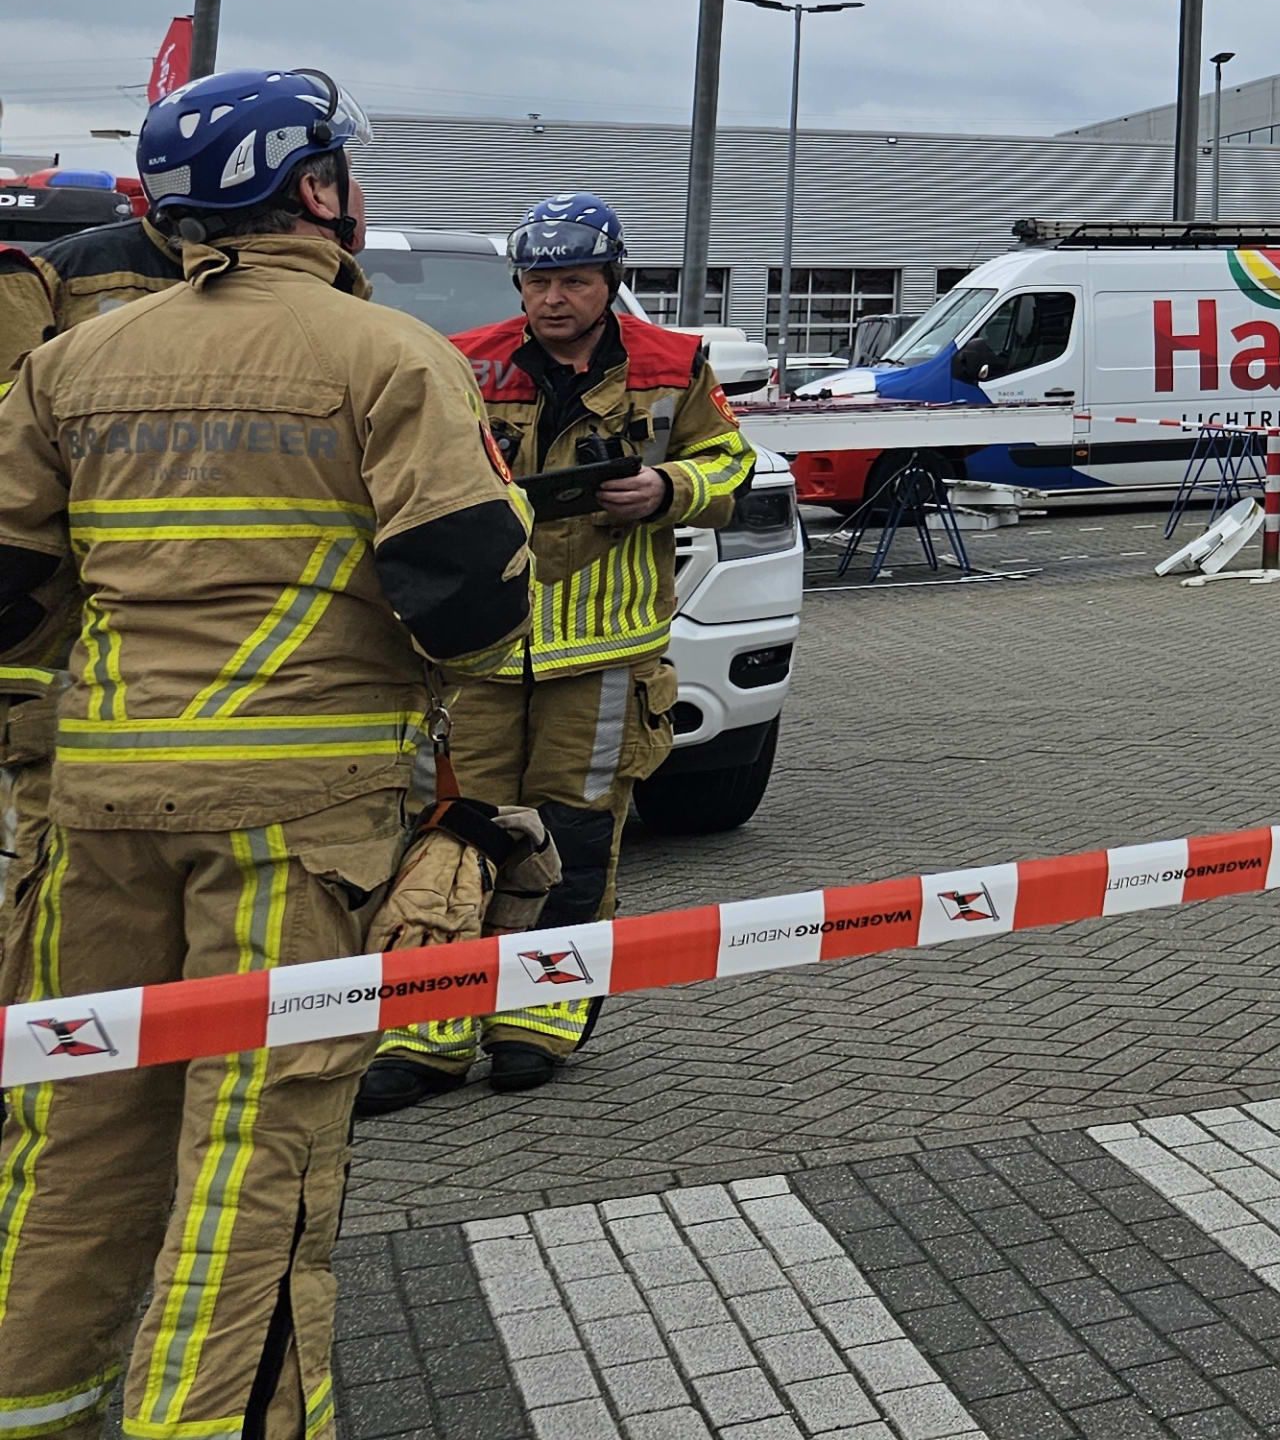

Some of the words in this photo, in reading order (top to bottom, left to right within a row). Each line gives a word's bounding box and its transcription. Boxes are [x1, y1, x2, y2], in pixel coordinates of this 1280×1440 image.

[67, 421, 338, 460] BRANDWEER
[151, 463, 222, 482] Twente
[1107, 872, 1159, 891] NEDLIFT
[1162, 858, 1262, 882] WAGENBORG
[795, 909, 912, 937] WAGENBORG
[728, 928, 791, 948] NEDLIFT
[347, 971, 488, 1003] WAGENBORG
[268, 992, 341, 1016] NEDLIFT
